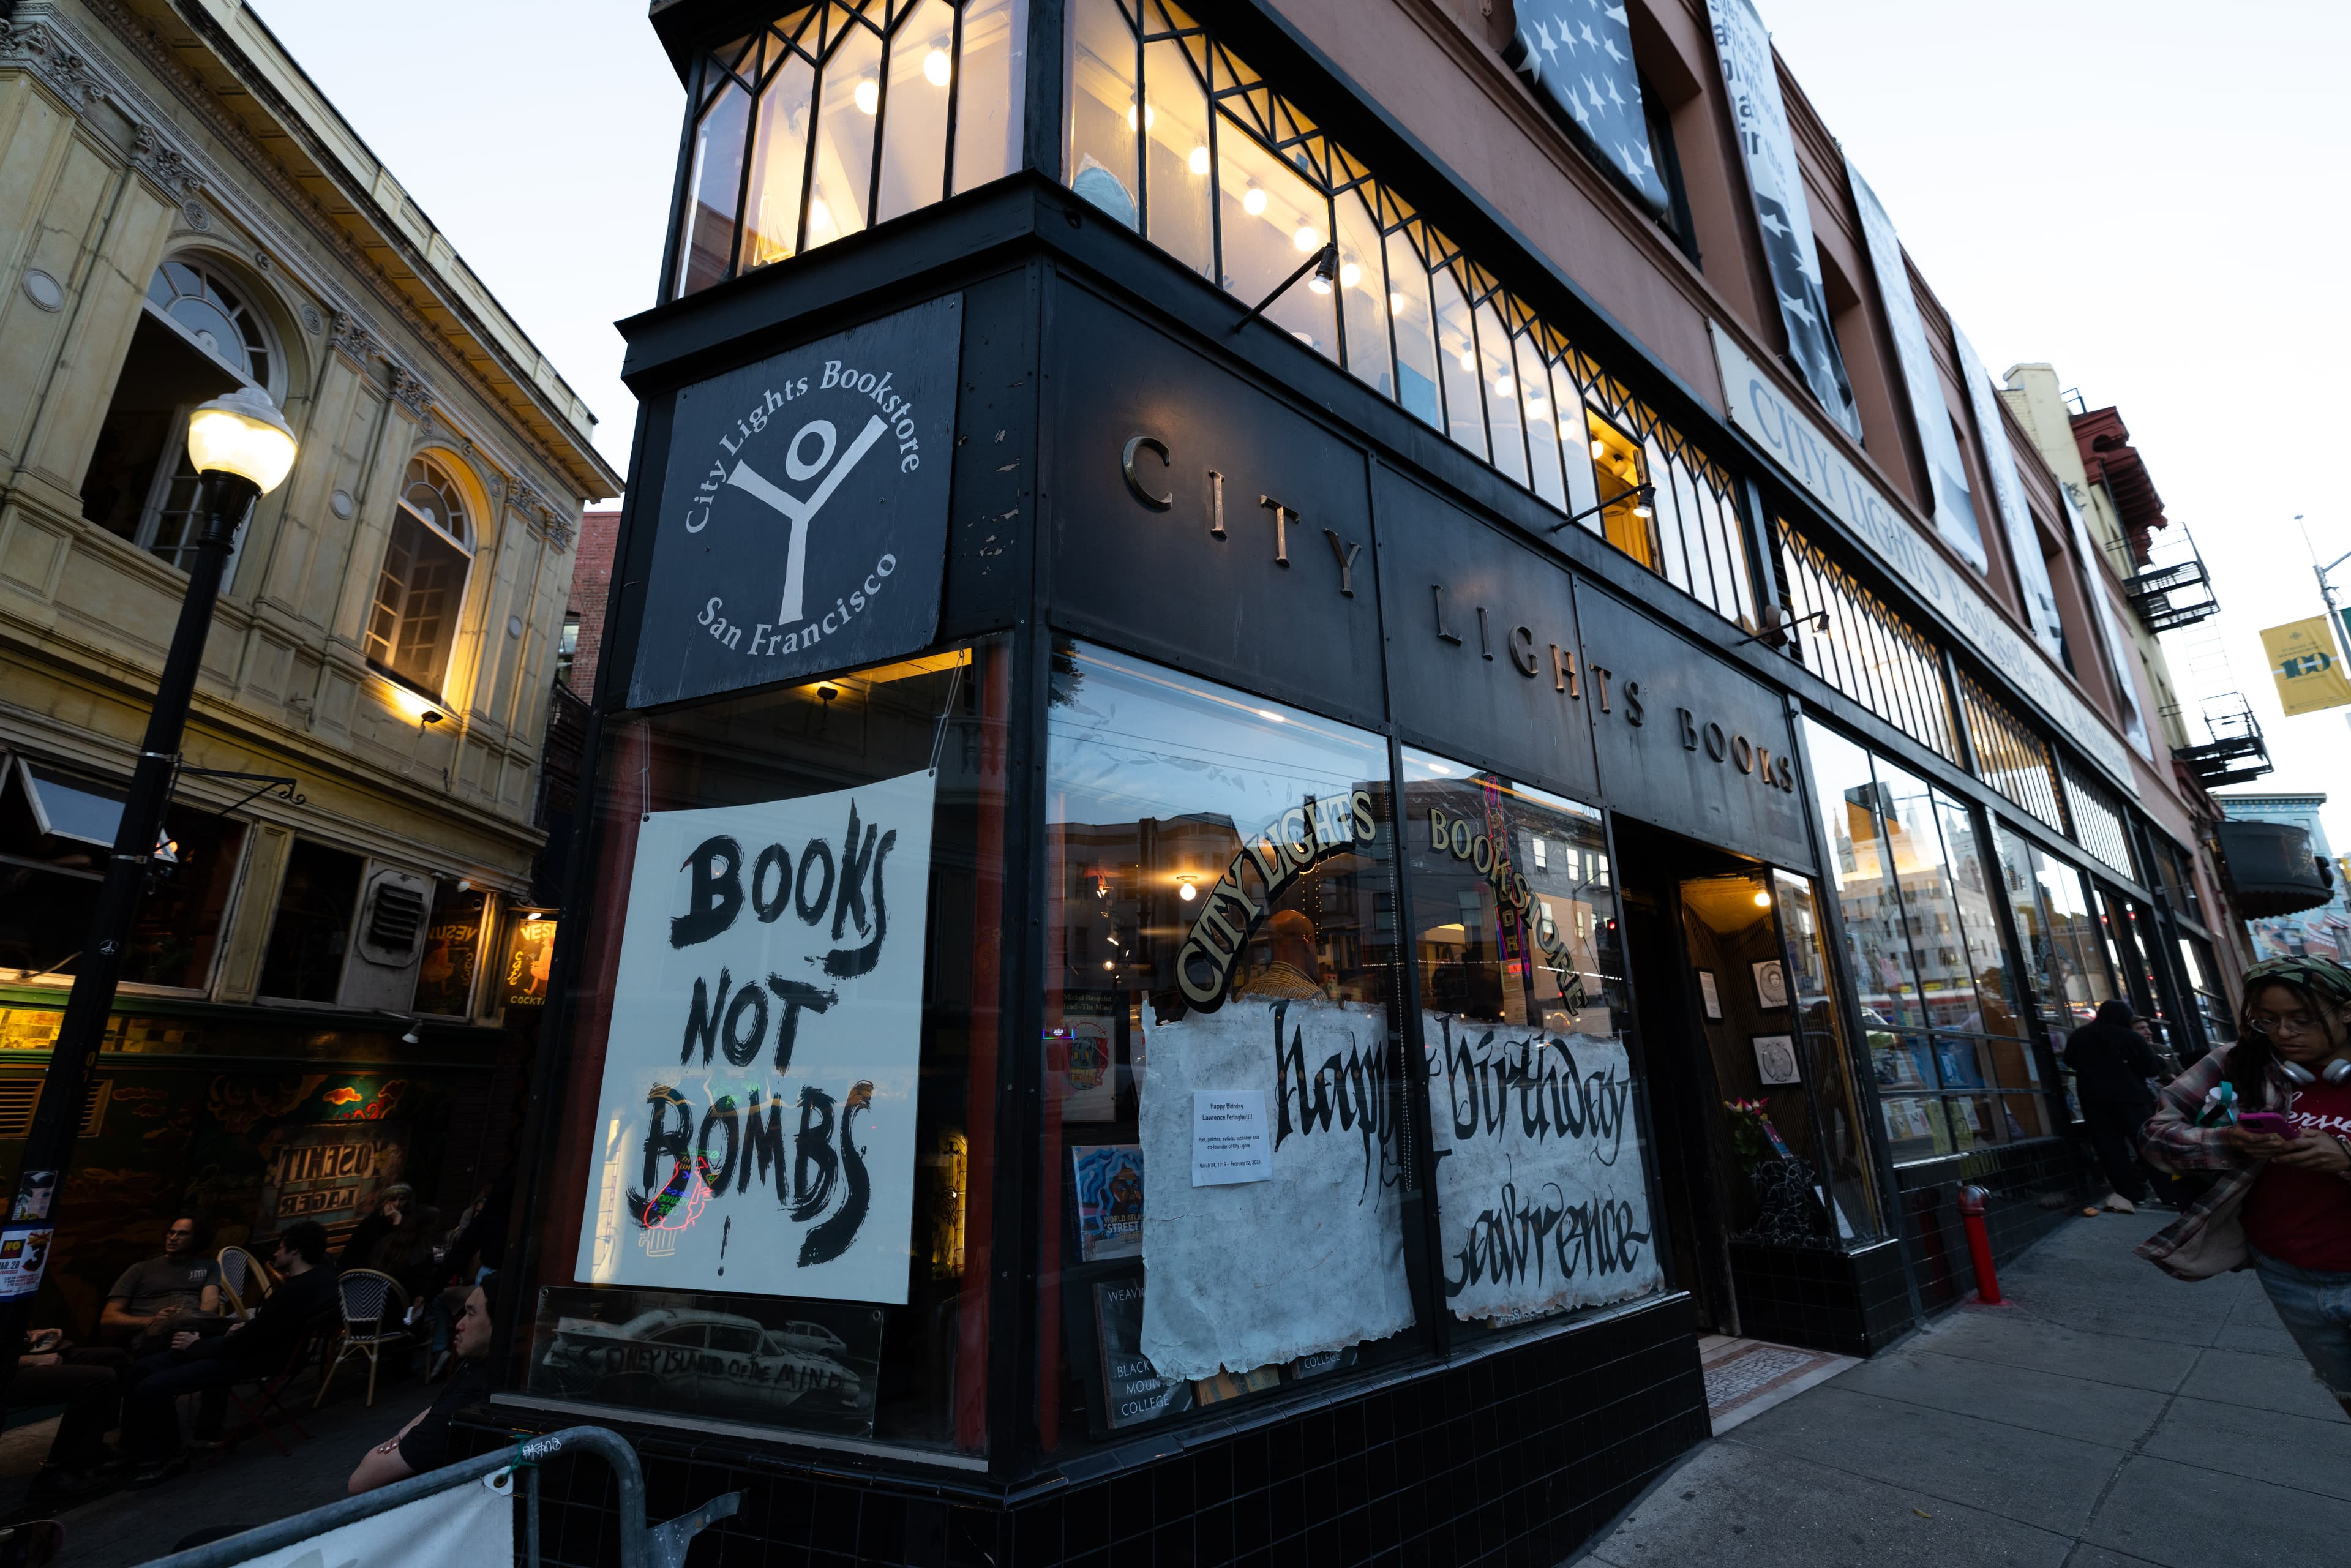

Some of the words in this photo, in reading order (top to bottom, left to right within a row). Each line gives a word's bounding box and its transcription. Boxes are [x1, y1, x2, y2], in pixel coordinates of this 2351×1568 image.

[685, 459, 729, 534] City
[719, 376, 808, 457] Lights
[819, 359, 920, 475] Bookstore
[1749, 378, 1835, 504] CITY
[697, 596, 743, 650] San
[747, 553, 896, 656] Francisco
[1121, 435, 1362, 599] CITY
[1431, 583, 1646, 728] LIGHTS
[1676, 706, 1794, 794] BOOKS
[2279, 652, 2331, 679] 100
[669, 797, 897, 980] BOOKS
[1176, 852, 1265, 1014] CITY
[1243, 789, 1377, 907] LIGHTS
[1427, 806, 1589, 1016] BOOKSTORE
[680, 965, 839, 1076] NOT
[1085, 994, 1112, 1003] Basquiat
[626, 1078, 875, 1269] BOMBS
[1103, 1215, 1126, 1223] WORLD
[10, 1260, 20, 1269] 28
[1107, 1221, 1139, 1233] STREET
[1117, 1360, 1150, 1378] BLACK
[1121, 1395, 1171, 1417] COLLEGE
[1303, 1351, 1342, 1369] COLLEGE
